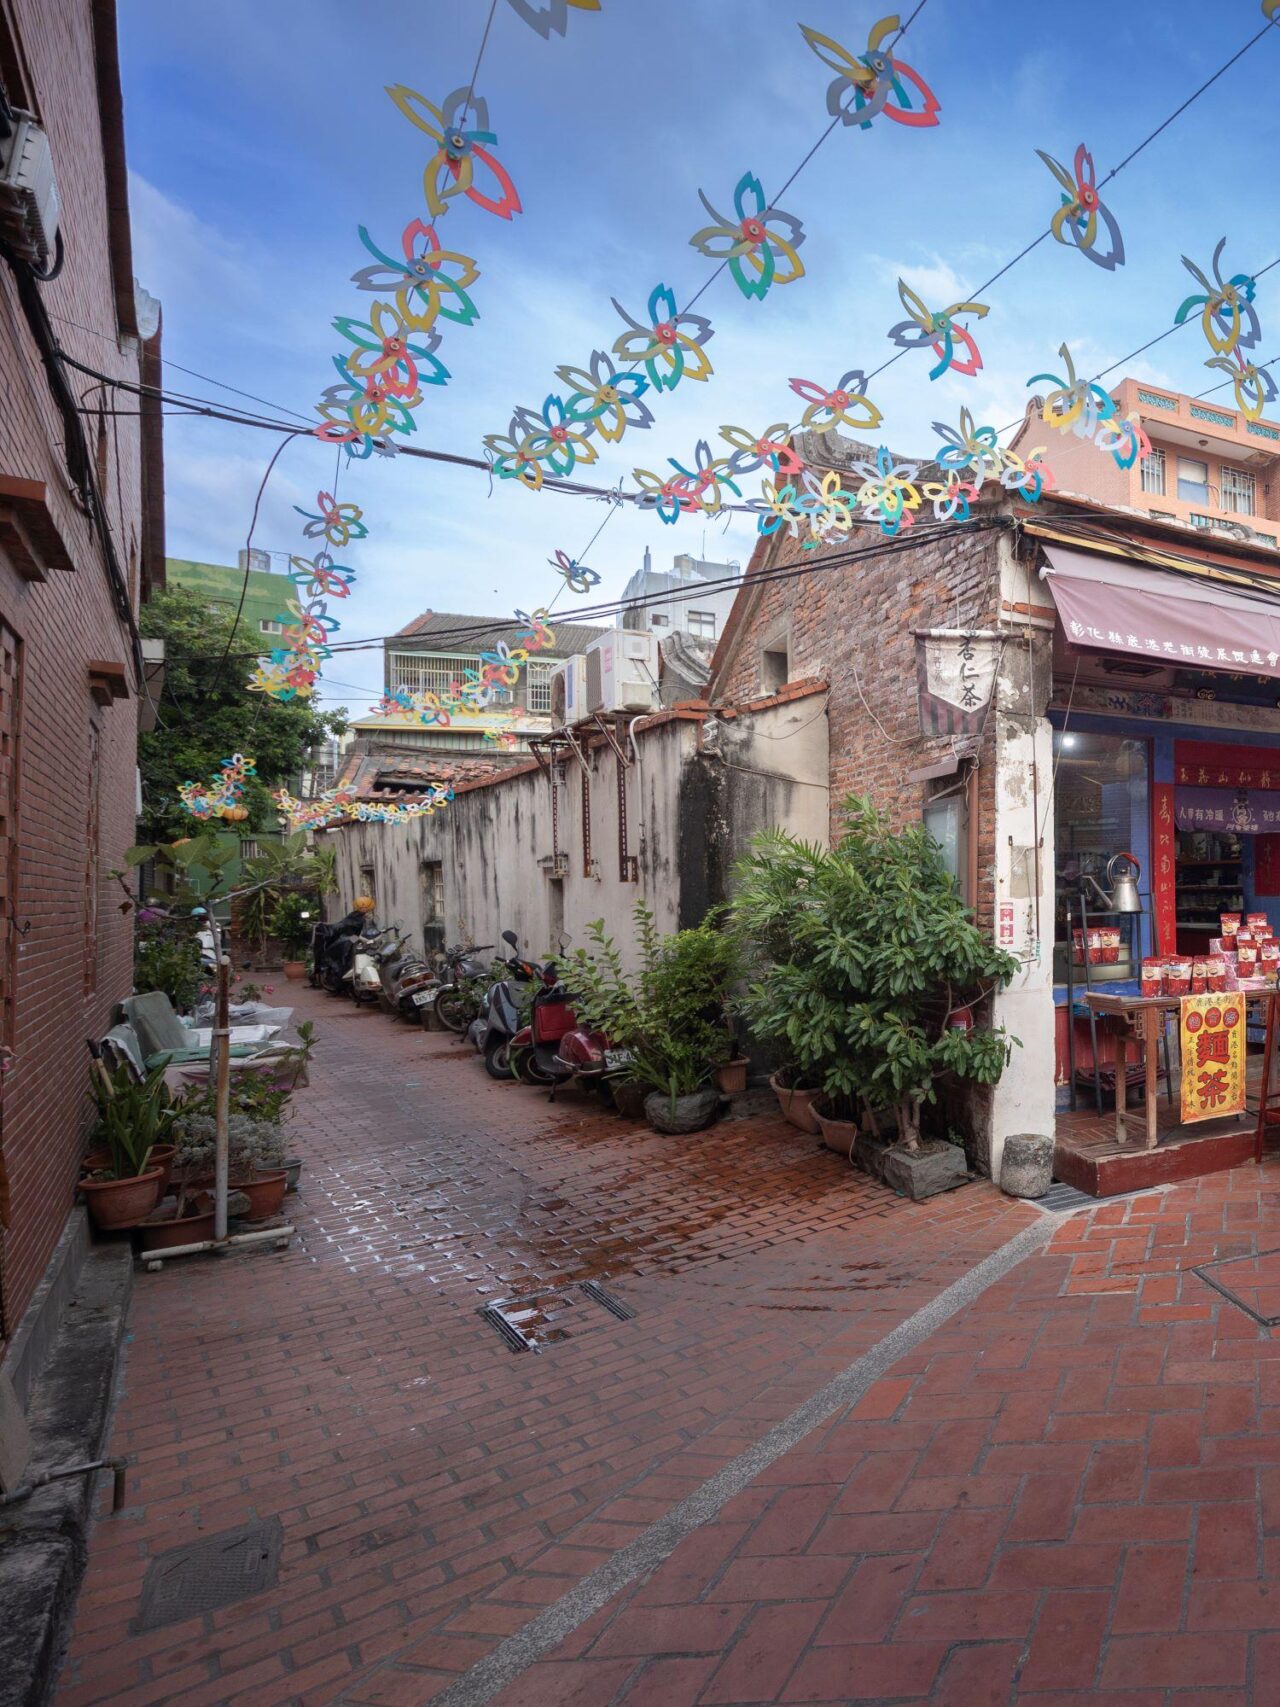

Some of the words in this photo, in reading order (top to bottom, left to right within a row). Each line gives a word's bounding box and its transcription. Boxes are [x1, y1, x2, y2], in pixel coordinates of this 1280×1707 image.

[957, 630, 983, 707] 杏仁茶
[1195, 1029, 1231, 1110] 麵茶
